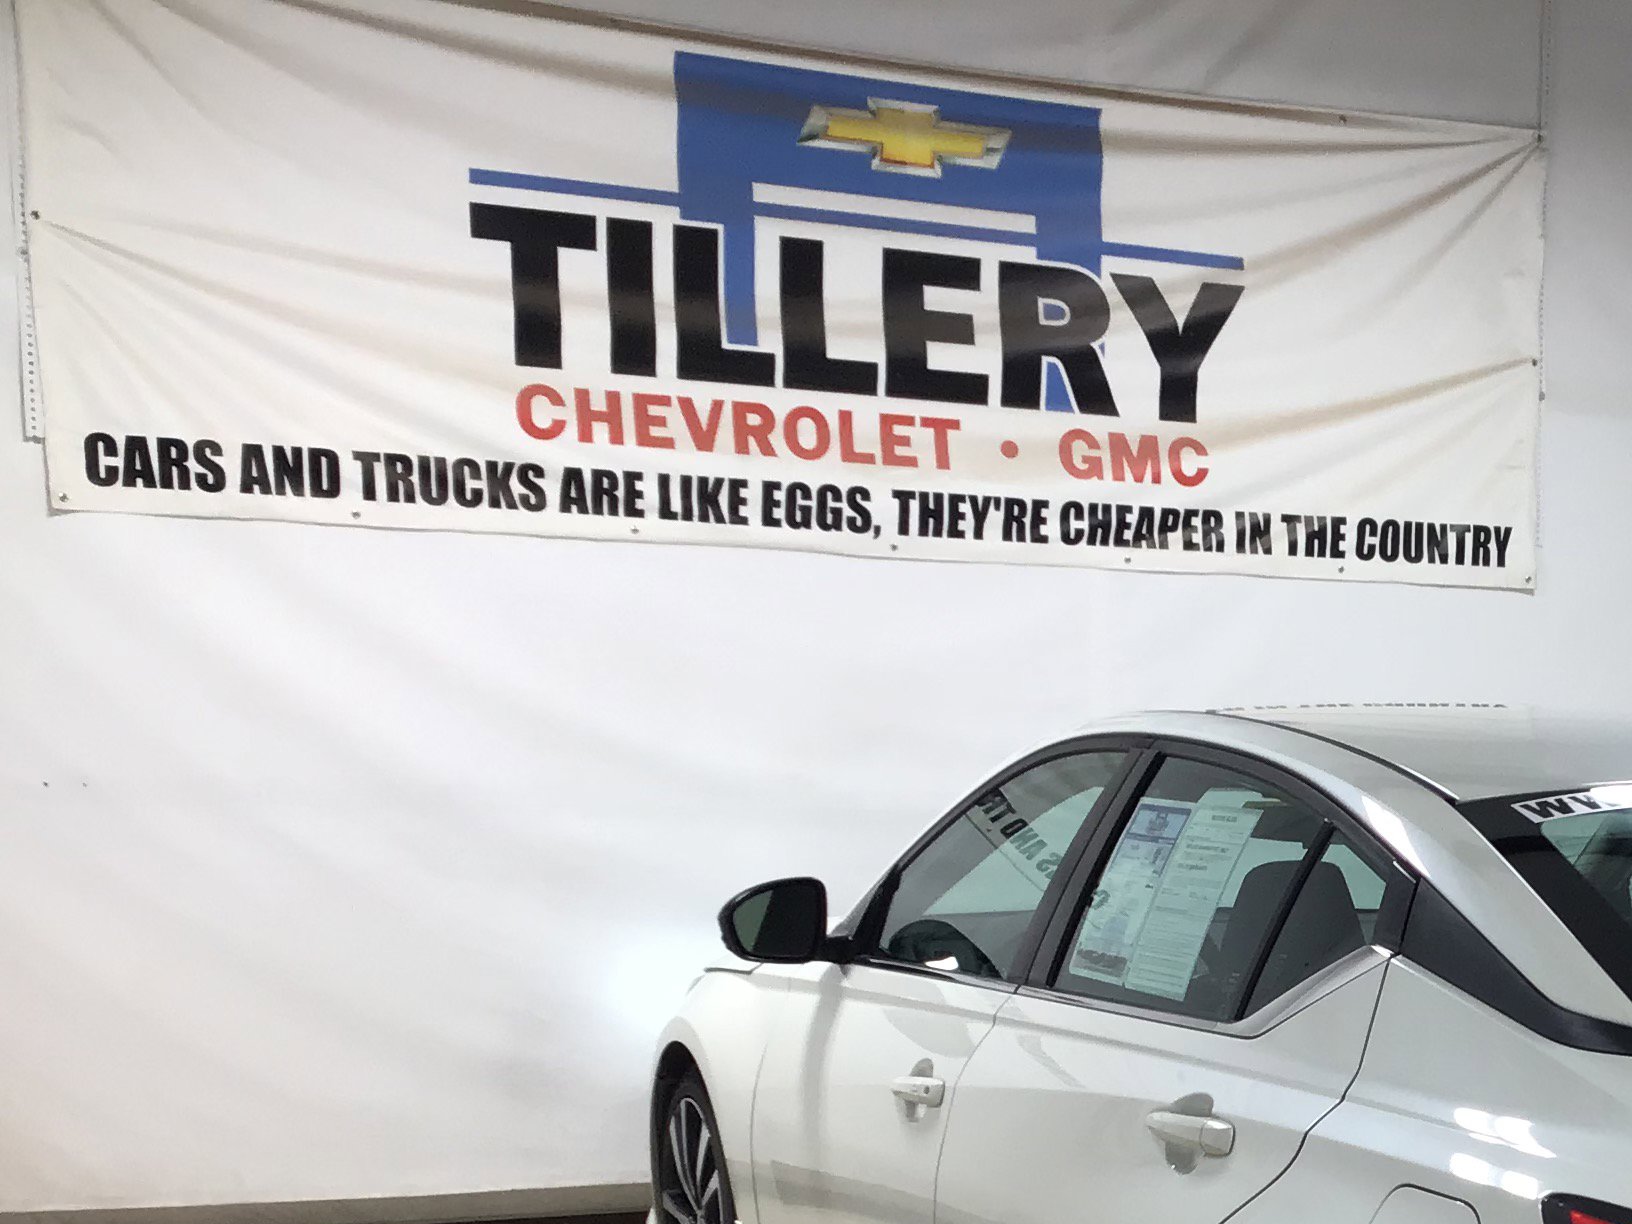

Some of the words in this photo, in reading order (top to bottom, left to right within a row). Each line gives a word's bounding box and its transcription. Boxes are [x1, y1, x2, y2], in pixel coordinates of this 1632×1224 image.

[469, 201, 1246, 424] TILLERY
[84, 432, 226, 493] CARS
[239, 443, 341, 499] AND
[353, 450, 547, 512] TRUCKS
[559, 466, 645, 519] ARE
[657, 472, 749, 526] LIKE
[761, 480, 881, 540] EGGS,
[892, 488, 1050, 544] THEY'RE
[1059, 499, 1225, 553] CHEAPER
[1235, 511, 1272, 555] IN
[1280, 513, 1347, 559] THE
[1355, 517, 1513, 568] COUNTRY
[515, 383, 962, 471] CHEVROLET
[1058, 427, 1211, 488] GMC
